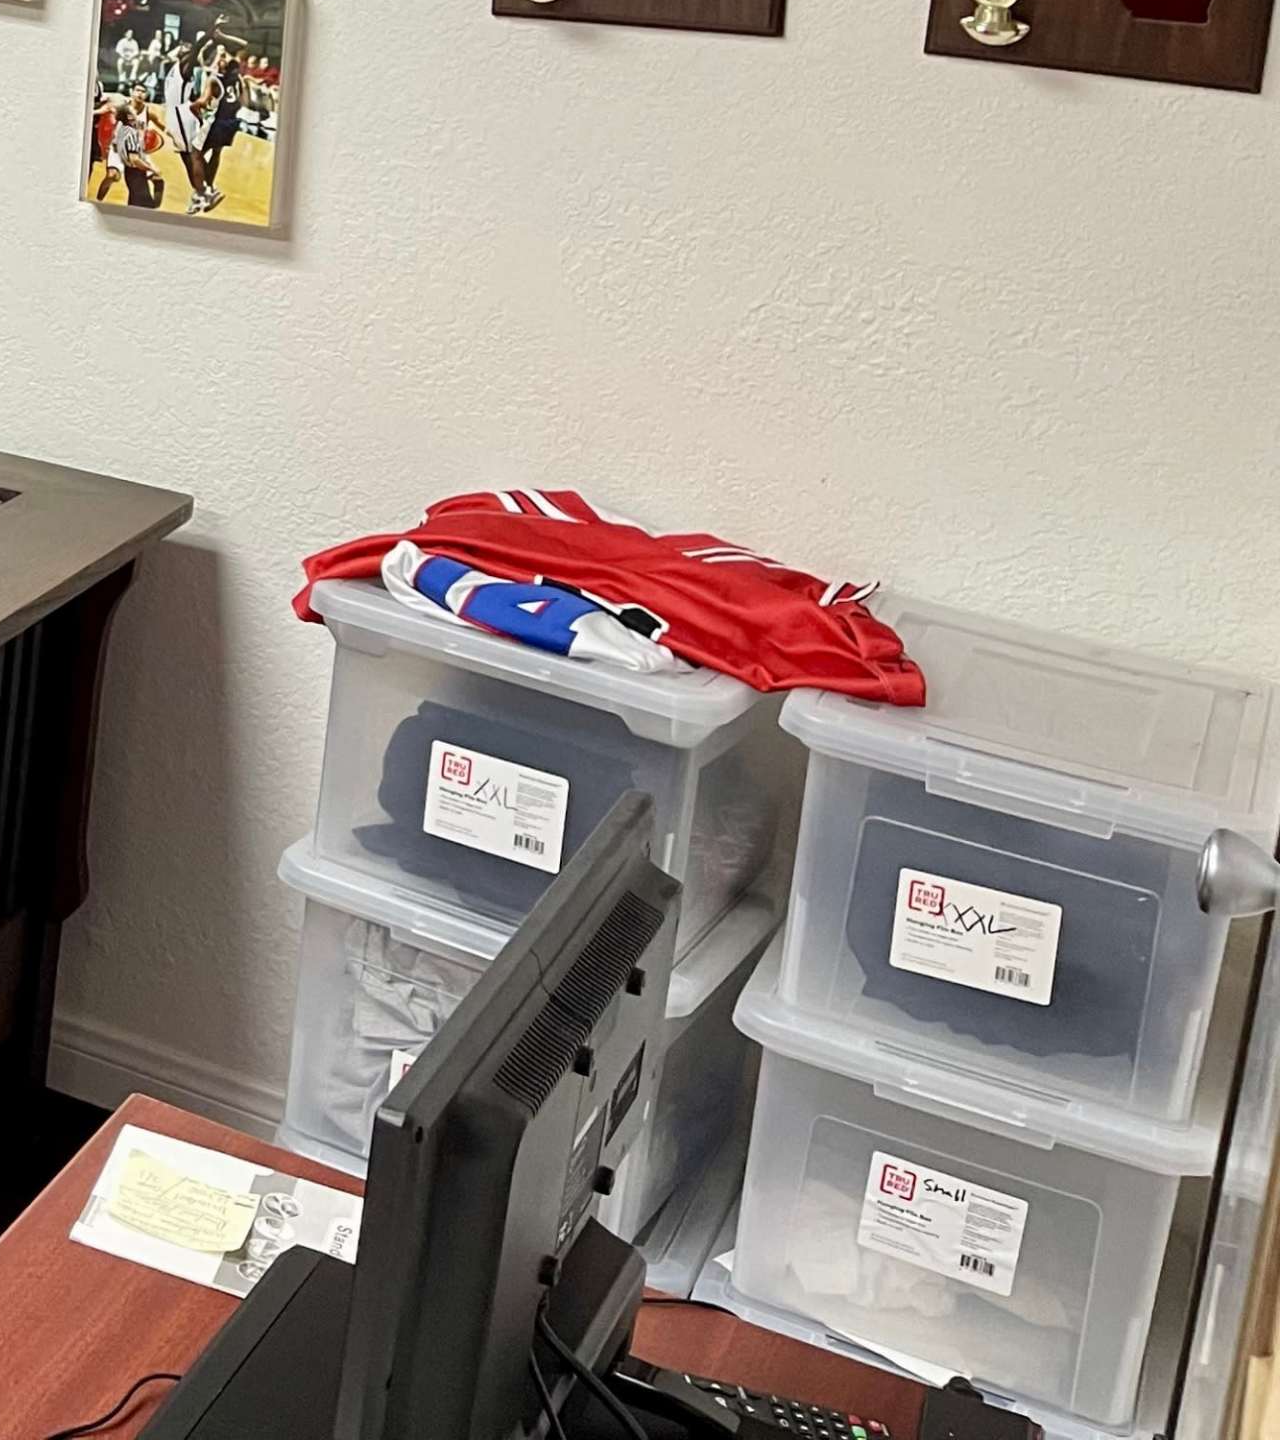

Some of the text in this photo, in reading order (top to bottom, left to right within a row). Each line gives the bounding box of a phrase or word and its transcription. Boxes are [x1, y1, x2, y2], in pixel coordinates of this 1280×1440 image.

[916, 887, 939, 899] TRU
[914, 896, 938, 908] RED
[888, 1172, 911, 1186] TRU
[886, 1180, 910, 1193] RED
[923, 1178, 967, 1202] Small
